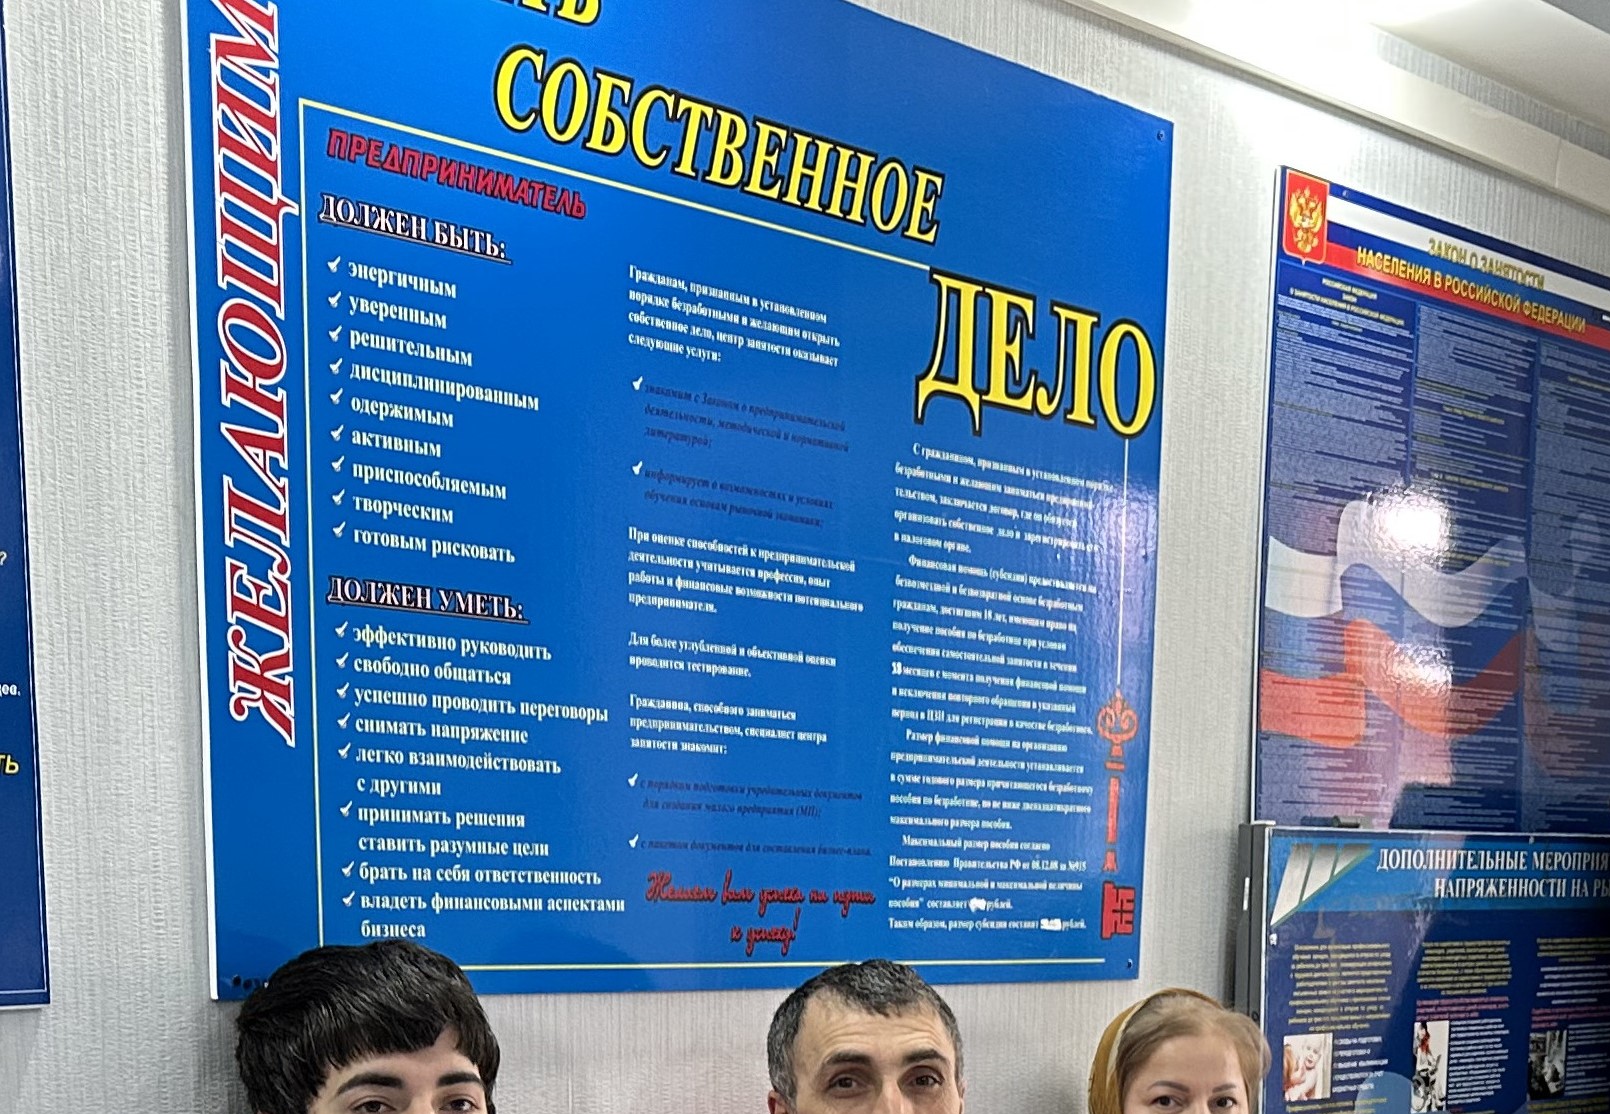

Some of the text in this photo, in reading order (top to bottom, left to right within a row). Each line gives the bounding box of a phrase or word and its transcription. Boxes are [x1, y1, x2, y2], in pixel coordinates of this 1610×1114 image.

[494, 45, 944, 245] СОБСТВЕННОЕ
[326, 127, 587, 220] ПРЕДПРИНИМАТЕЛЬ
[320, 194, 507, 259] ДОЛЖЕН БЫТЬ:
[348, 262, 457, 299] энергичным
[1357, 246, 1432, 286] НАСЕЛЕНИЯ
[1434, 271, 1443, 289] В
[1445, 273, 1521, 314] РОССИЙСКОЙ
[1523, 299, 1587, 334] ФЕДЕРАЦИИ
[349, 295, 447, 329] уверенным
[350, 330, 473, 366] решительным
[914, 268, 1155, 437] ДЕЛО
[210, 0, 299, 747] ЖЕЛАЮЩИМ
[349, 363, 539, 411] дисциплинированным
[350, 397, 454, 427] одержимым
[351, 430, 441, 457] активным
[352, 463, 507, 500] приспособляемым
[352, 496, 454, 524] творческим
[354, 529, 516, 563] готовым рисковать
[327, 576, 523, 620] ДОЛЖЕН УМЕТЬ:
[352, 625, 552, 660] эффективно руководить
[353, 656, 511, 685] свободно общаться
[354, 688, 609, 725] успешно проводить переговоры
[355, 718, 529, 744] снимать напряжение
[355, 748, 562, 773] легко взаимодействовать
[356, 778, 441, 798] с другими
[358, 808, 525, 830] принимать решения
[358, 837, 549, 858] ставить разумные цели
[1376, 848, 1528, 873] ДОПОЛНИТЕЛЬНЫЕ
[359, 862, 602, 885] брать на себя ответственность
[1434, 877, 1566, 899] НАПРЯЖЕННОСТИ
[1570, 877, 1591, 898] НА
[360, 892, 625, 914] владеть финансовыми аспектами
[360, 920, 426, 938] бизнеса
